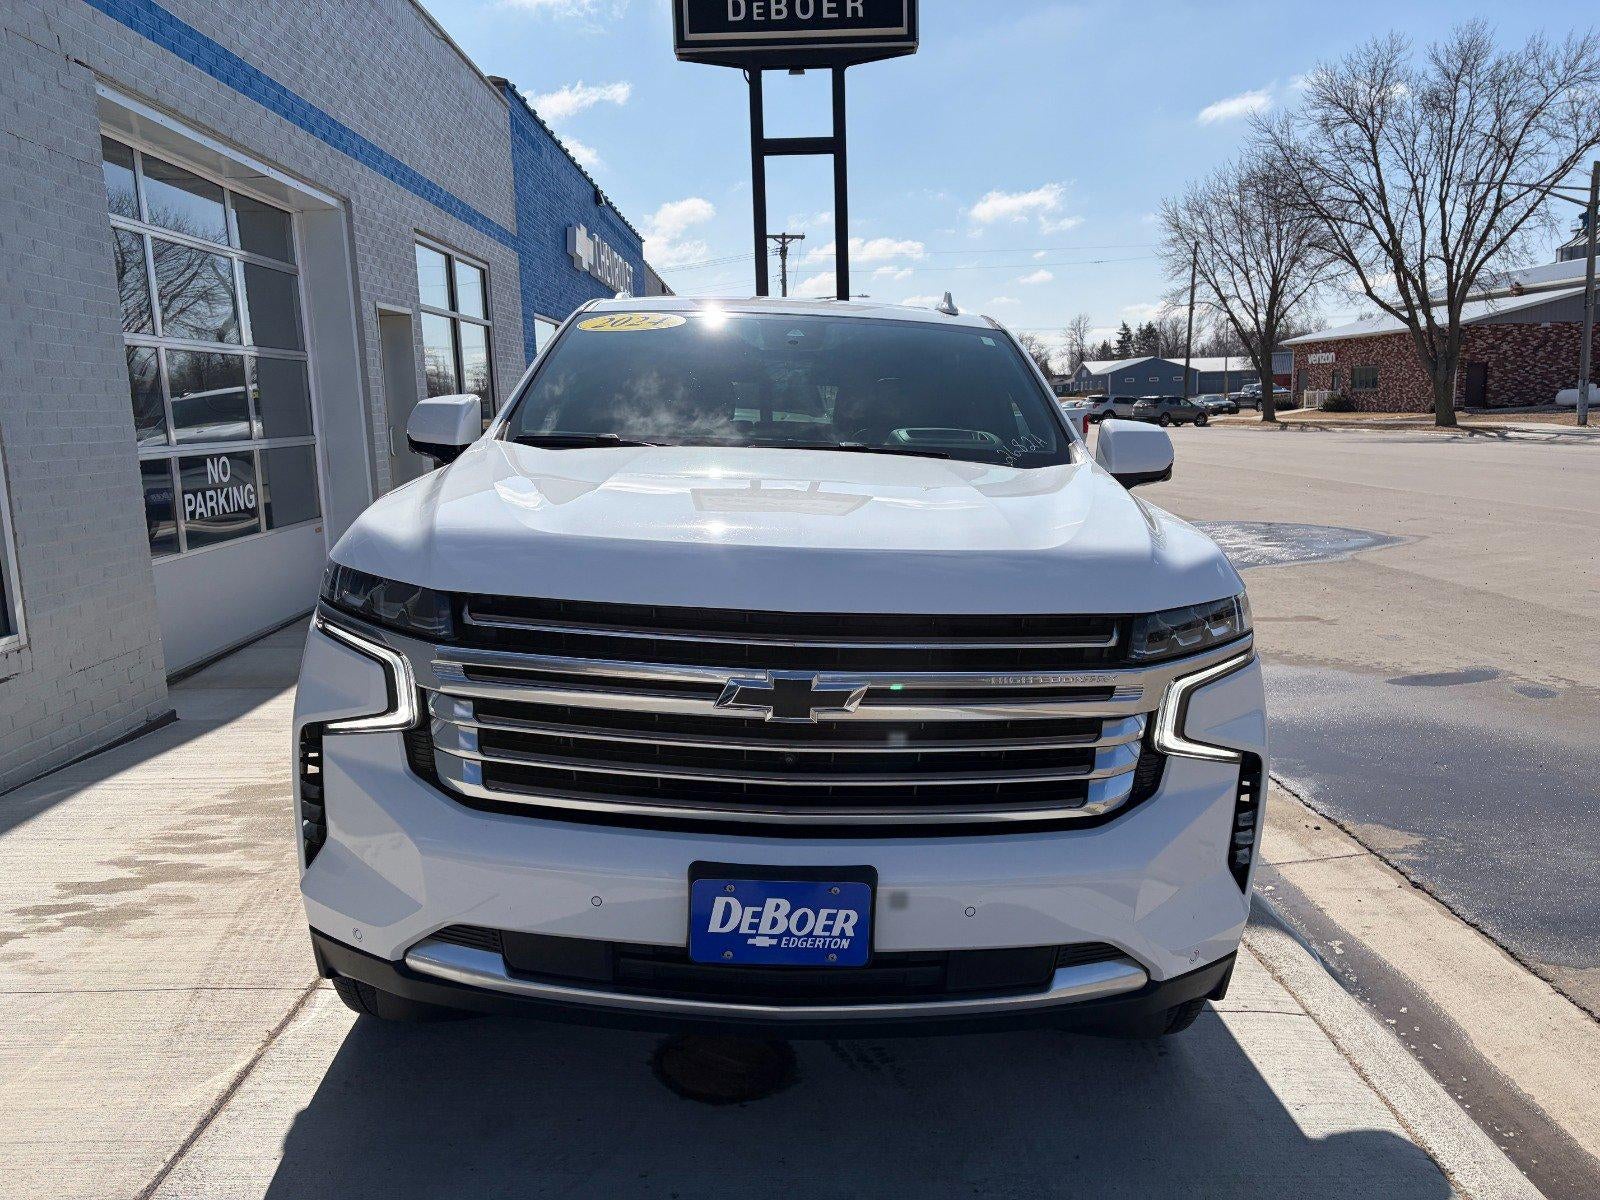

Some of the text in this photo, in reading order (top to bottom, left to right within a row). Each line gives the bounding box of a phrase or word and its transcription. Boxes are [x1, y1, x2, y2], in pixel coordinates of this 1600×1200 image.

[592, 233, 634, 297] CHEVROLET
[590, 315, 673, 328] 2024
[1307, 350, 1336, 365] verizon
[206, 456, 231, 485] NO
[183, 483, 257, 522] PARKING
[780, 936, 851, 950] EDGERTON
